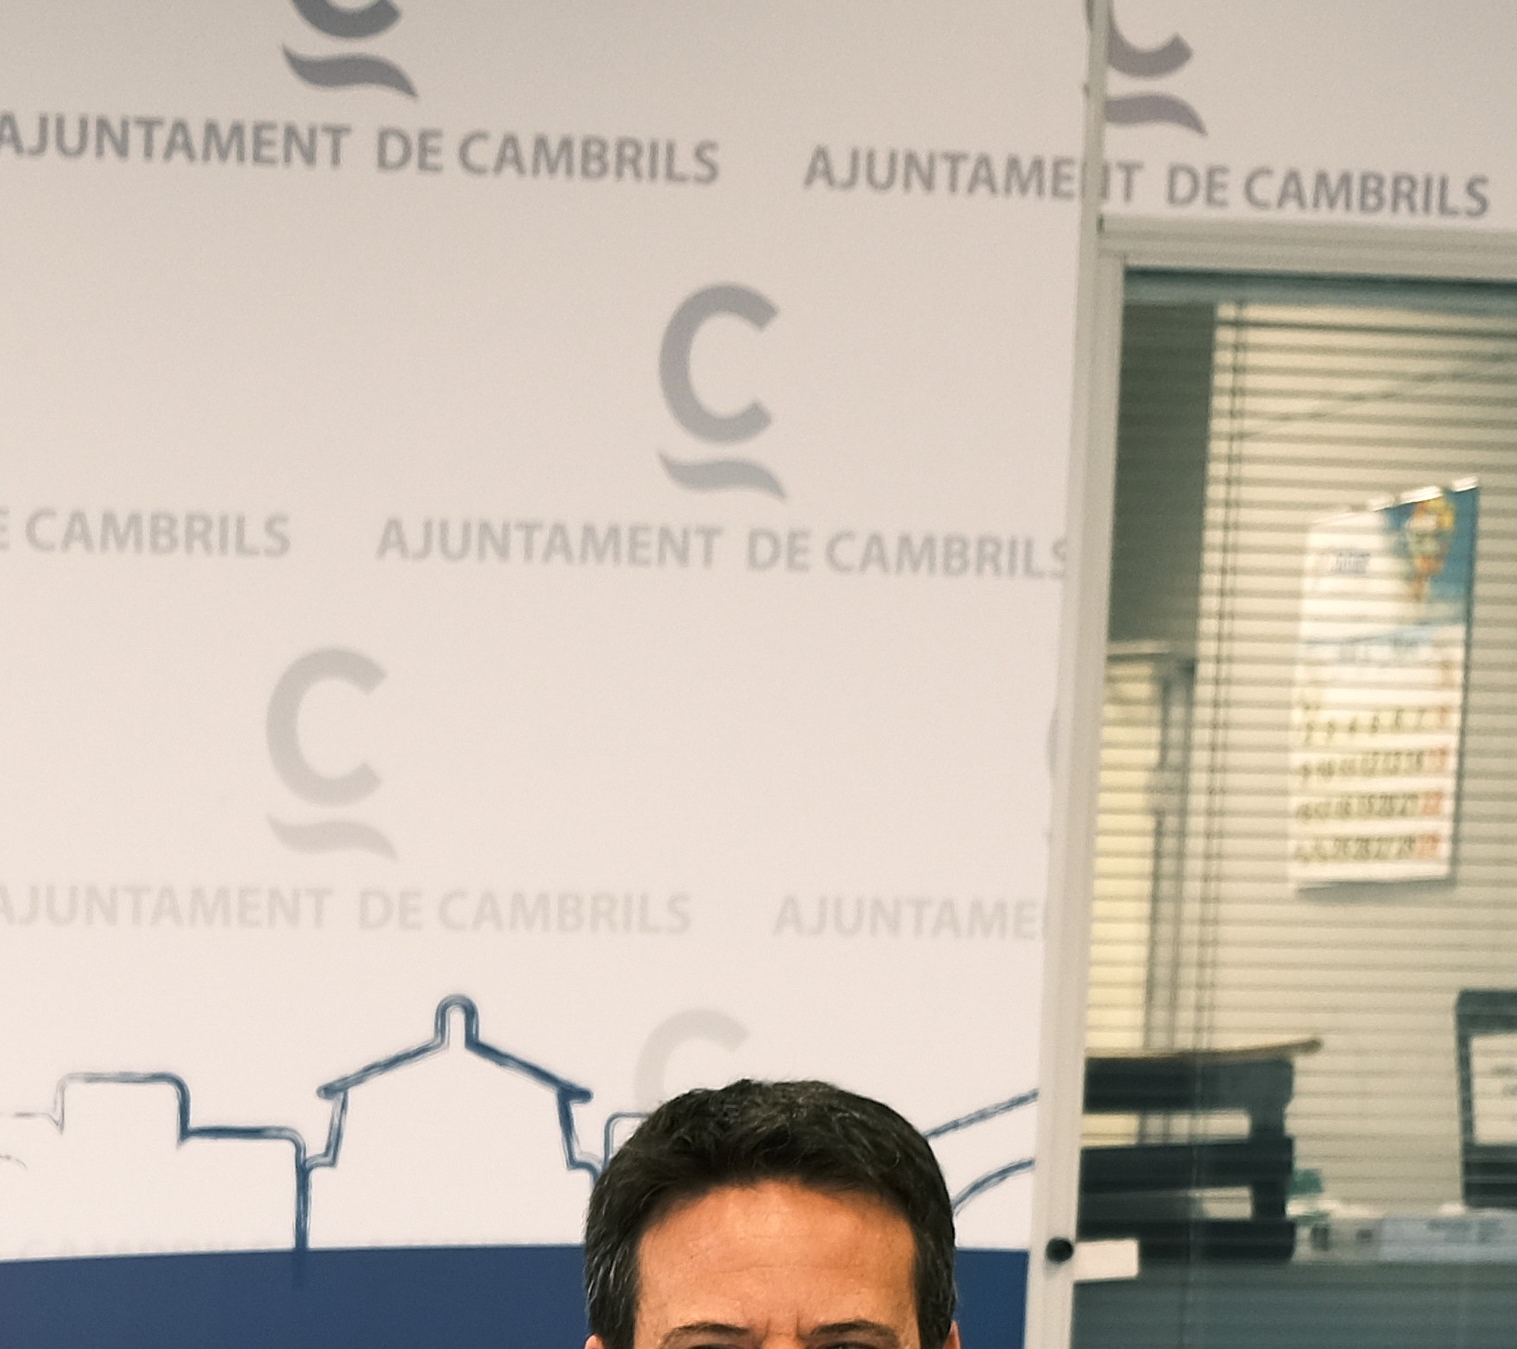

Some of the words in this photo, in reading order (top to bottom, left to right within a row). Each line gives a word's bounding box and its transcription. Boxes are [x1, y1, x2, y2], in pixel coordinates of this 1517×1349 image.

[376, 127, 444, 174] DE
[459, 129, 721, 186] CAMBRILS
[1165, 162, 1229, 211] DE
[1244, 165, 1490, 220] CAMBRILS
[26, 507, 292, 561] CAMBRILS
[376, 517, 724, 572] AJUNTAMENT
[745, 525, 809, 574] DE
[358, 888, 425, 932] DE
[437, 890, 692, 937] CAMBRILS
